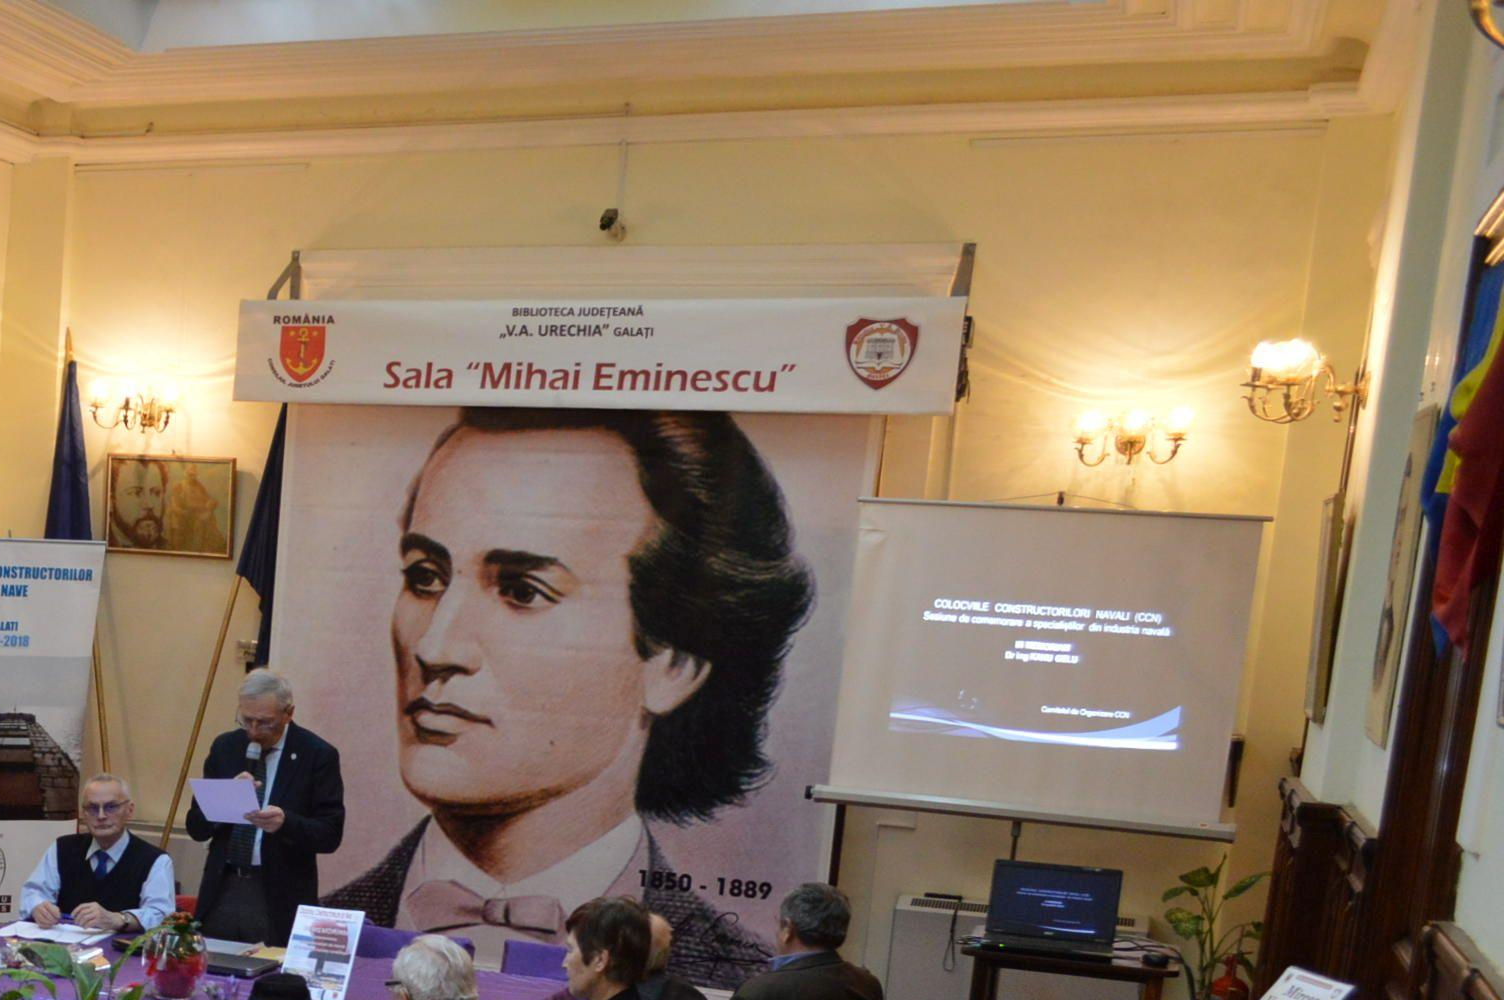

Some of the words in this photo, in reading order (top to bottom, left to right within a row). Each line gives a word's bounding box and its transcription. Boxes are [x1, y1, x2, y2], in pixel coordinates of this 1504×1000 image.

[273, 313, 335, 324] ROMÂNIA
[512, 307, 575, 318] BIBLIOTECA
[383, 361, 454, 389] Sala
[467, 361, 581, 390] “Mihai
[592, 362, 798, 393] Eminescu”
[1, 584, 28, 597] NAVE
[639, 869, 692, 892] 1850
[717, 877, 772, 900] 1889
